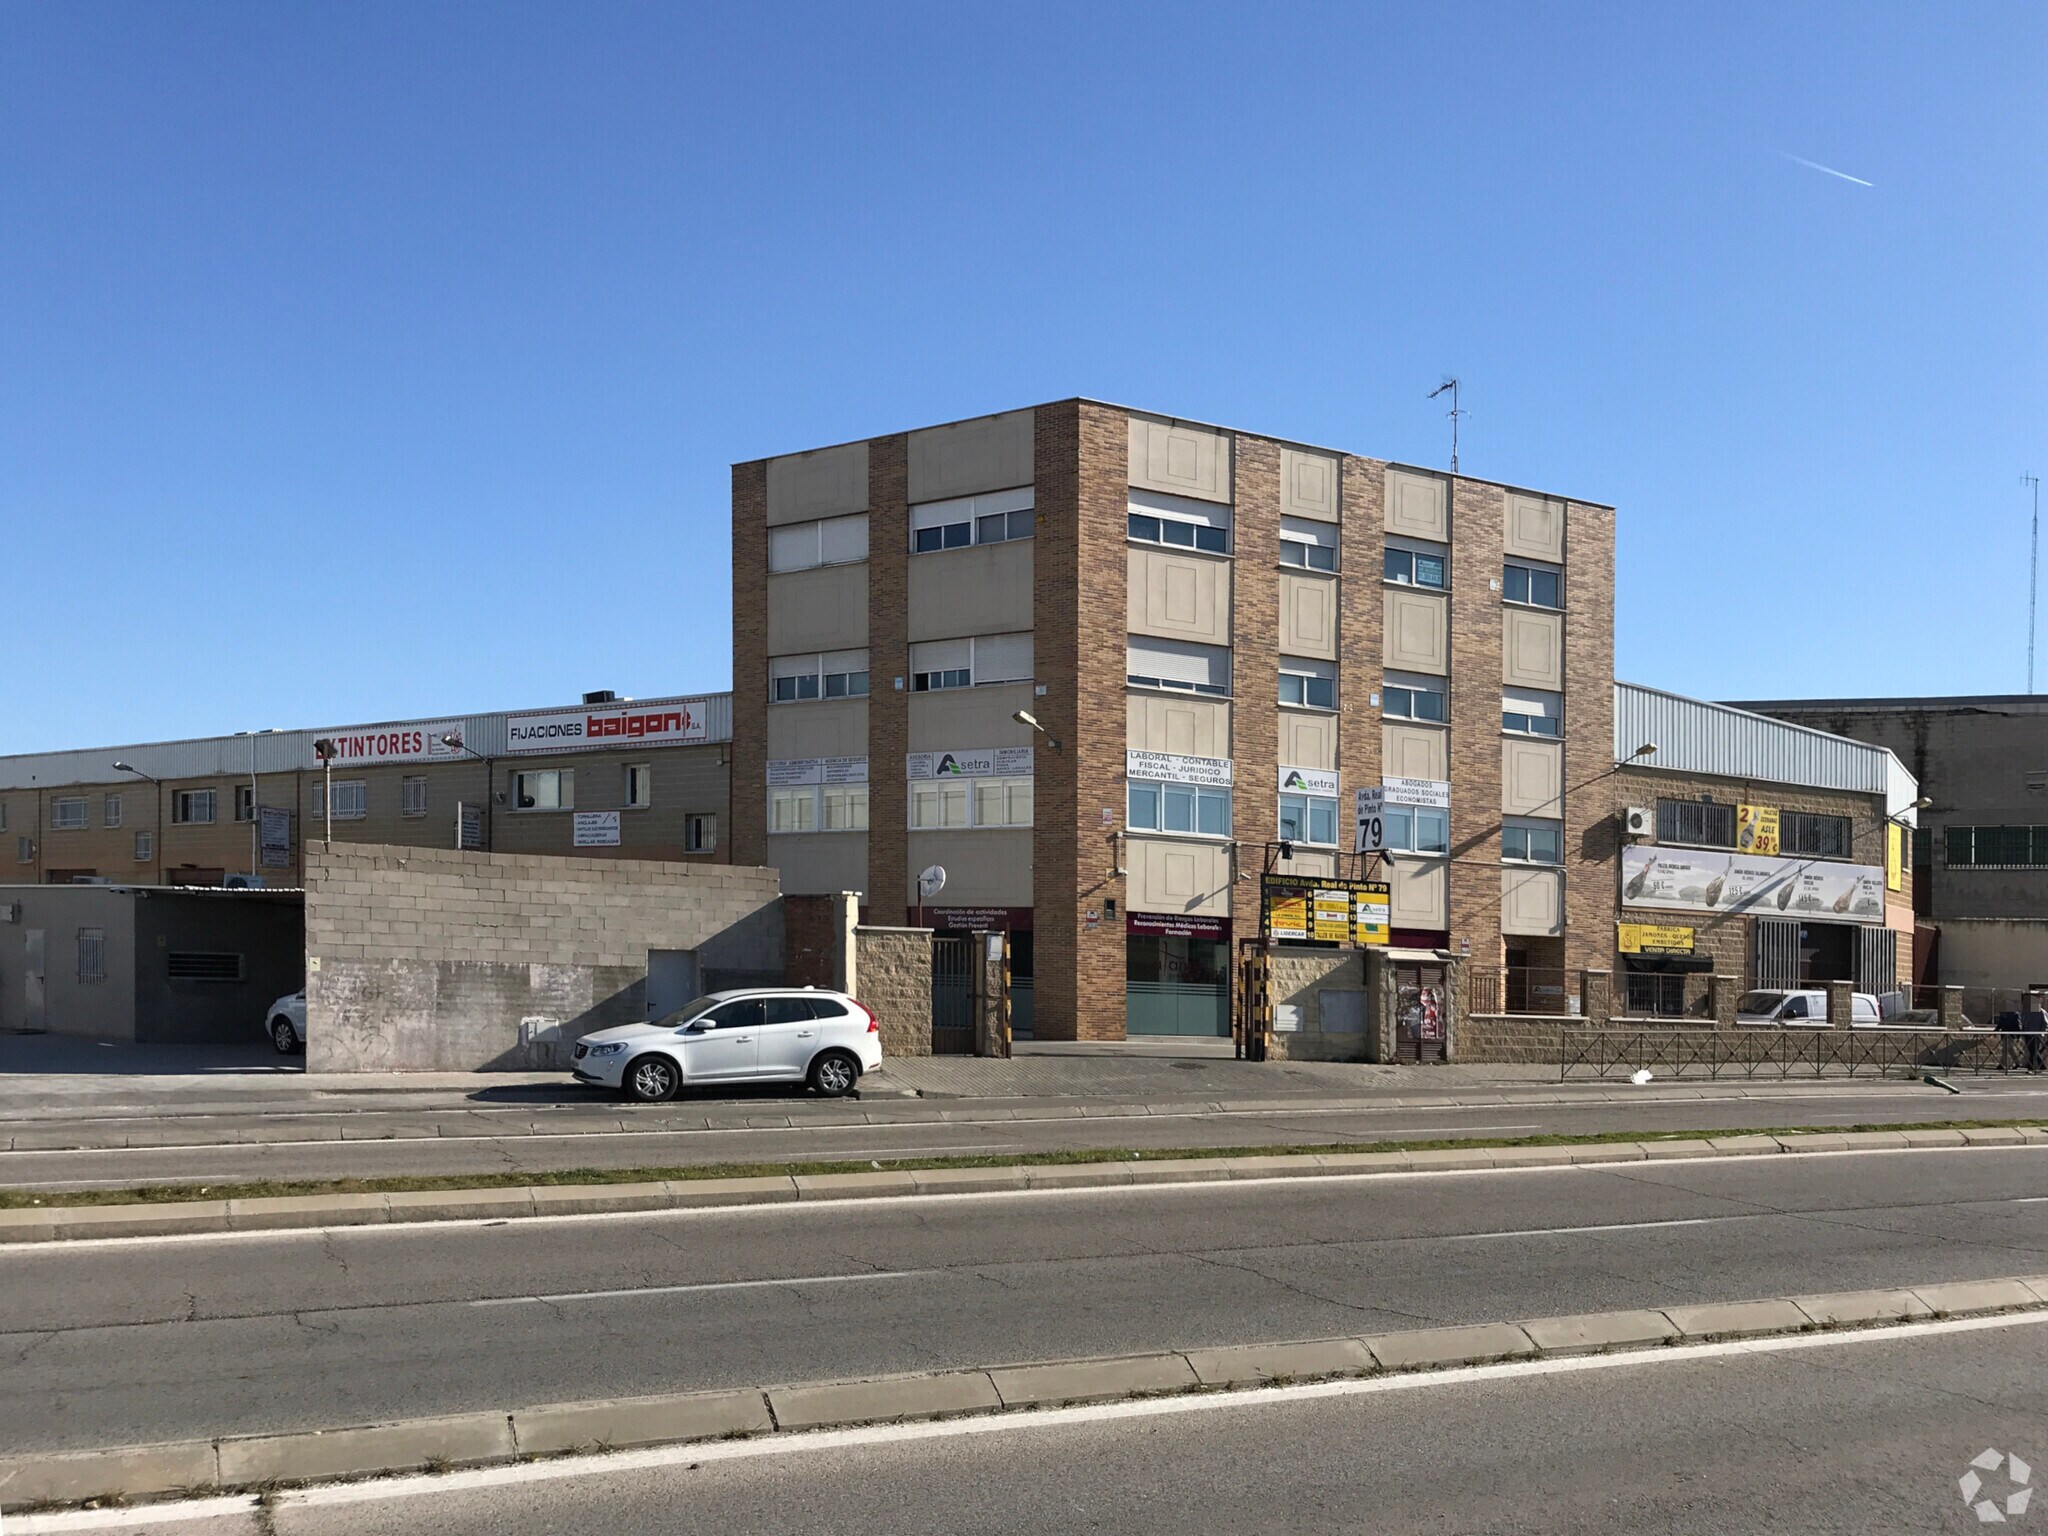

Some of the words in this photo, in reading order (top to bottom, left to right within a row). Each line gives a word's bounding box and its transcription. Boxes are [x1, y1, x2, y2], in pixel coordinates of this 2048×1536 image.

[511, 723, 582, 740] FIJACIONES
[587, 711, 681, 738] baigon
[316, 731, 422, 760] TINTORES
[936, 754, 990, 775] Asetra
[1130, 752, 1172, 762] LABORAL
[1182, 757, 1229, 768] CONTABLE
[1139, 762, 1170, 770] FISCAL
[1178, 766, 1220, 776] JURIDICO
[1129, 769, 1180, 780] MERCANTIL
[1188, 775, 1230, 785] SEGUROS
[1284, 770, 1334, 791] Asetra
[1402, 780, 1432, 788] ABOGADOS
[1397, 795, 1436, 805] ECONOMISTAS
[1422, 789, 1449, 798] SOCIALES
[1365, 804, 1376, 814] Pinto
[1739, 808, 1749, 822] 2
[1360, 817, 1382, 848] 79
[1266, 877, 1298, 885] EDIFICIO
[1322, 880, 1337, 888] Real
[1349, 882, 1367, 891] Pinto
[1378, 884, 1387, 892] 79
[1134, 920, 1174, 928] Reconocimientos
[1176, 921, 1196, 929] Médicos
[1165, 928, 1192, 936] Formación
